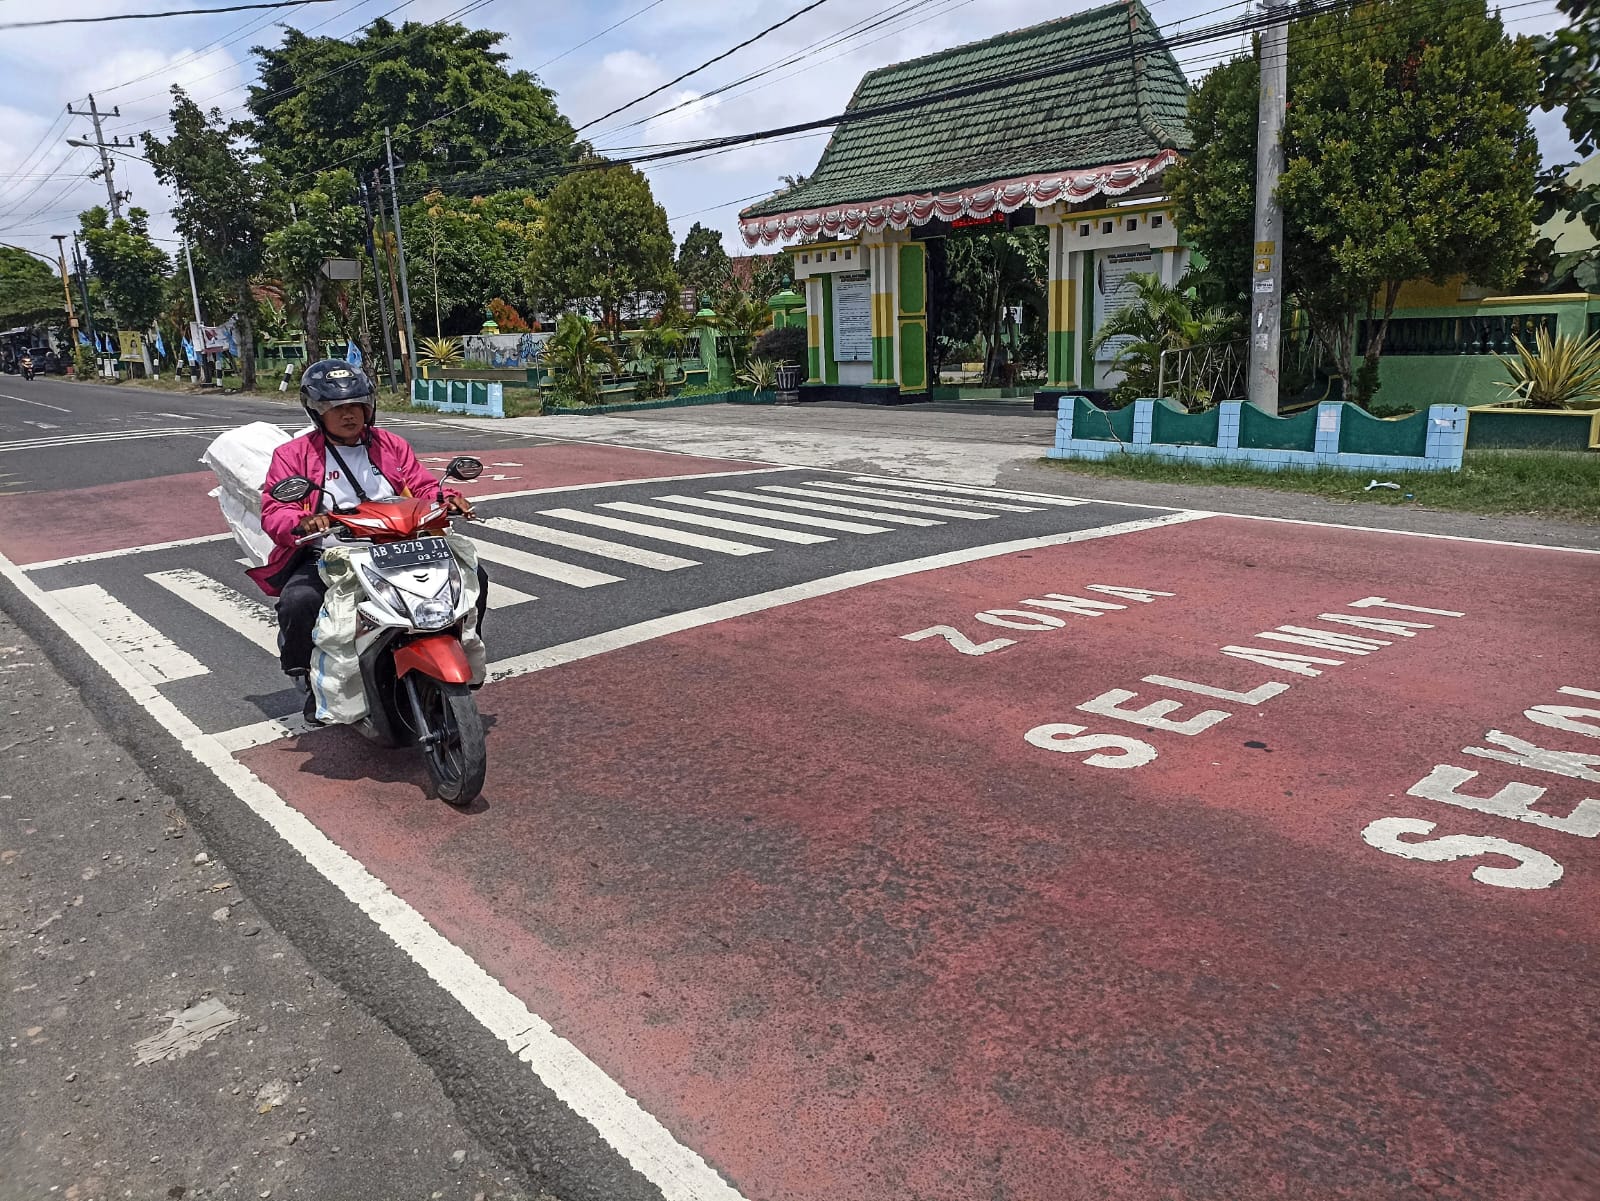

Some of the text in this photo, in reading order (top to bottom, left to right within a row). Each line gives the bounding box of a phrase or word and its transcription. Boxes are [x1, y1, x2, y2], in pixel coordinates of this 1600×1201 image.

[372, 546, 388, 558] AB
[392, 541, 424, 554] 5279
[899, 584, 1177, 656] ZONA
[1024, 596, 1466, 769] SELAMAT
